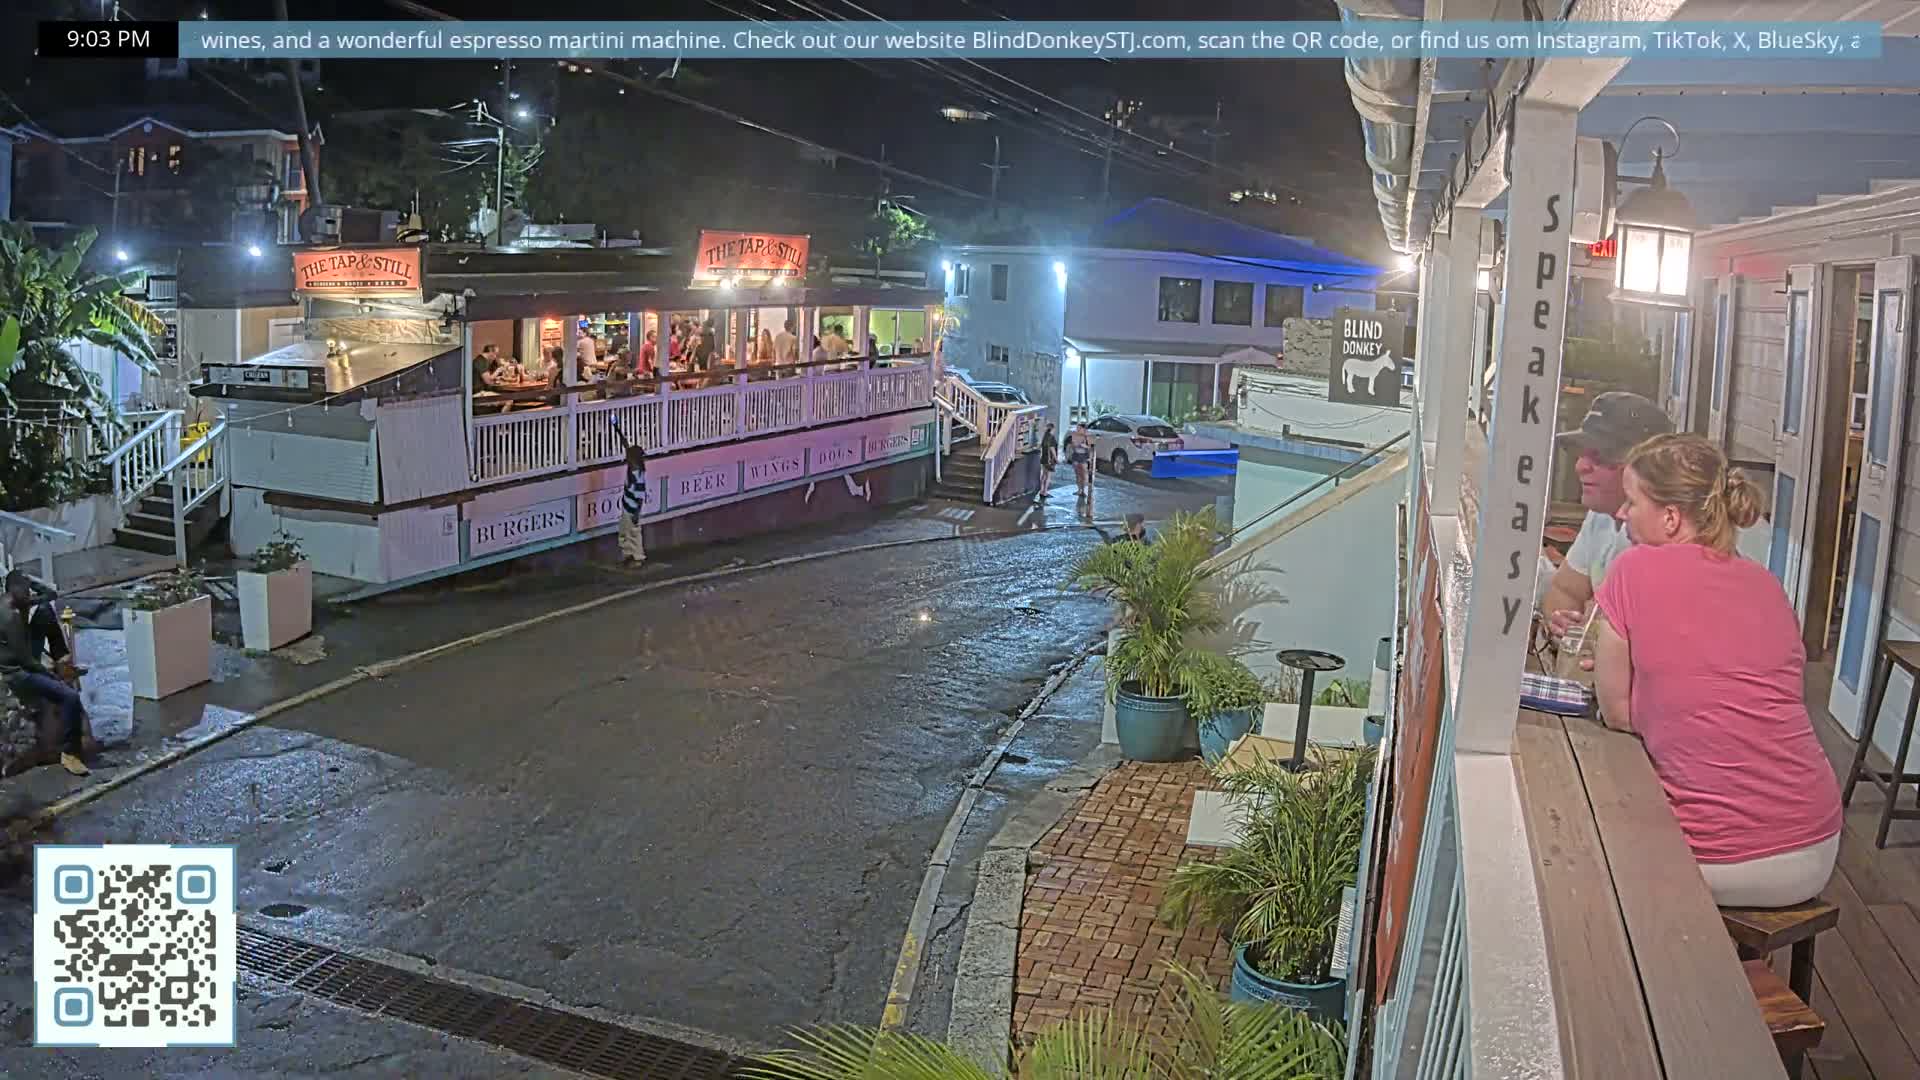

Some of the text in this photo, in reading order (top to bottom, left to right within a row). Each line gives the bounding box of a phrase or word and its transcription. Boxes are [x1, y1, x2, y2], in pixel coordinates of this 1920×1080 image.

[706, 241, 735, 265] THE
[738, 238, 764, 255] TAP
[778, 242, 802, 268] STILL
[1592, 239, 1617, 258] EXI
[301, 259, 328, 280] THE
[328, 255, 357, 270] TAP
[373, 256, 412, 279] STILL
[1344, 318, 1383, 339] BLIND
[1343, 340, 1383, 356] DONKEY
[868, 436, 909, 453] BURGERS
[818, 449, 854, 465] DOGS
[751, 458, 800, 480] WINGS
[681, 473, 726, 495] BEER
[476, 510, 566, 544] BURGERS
